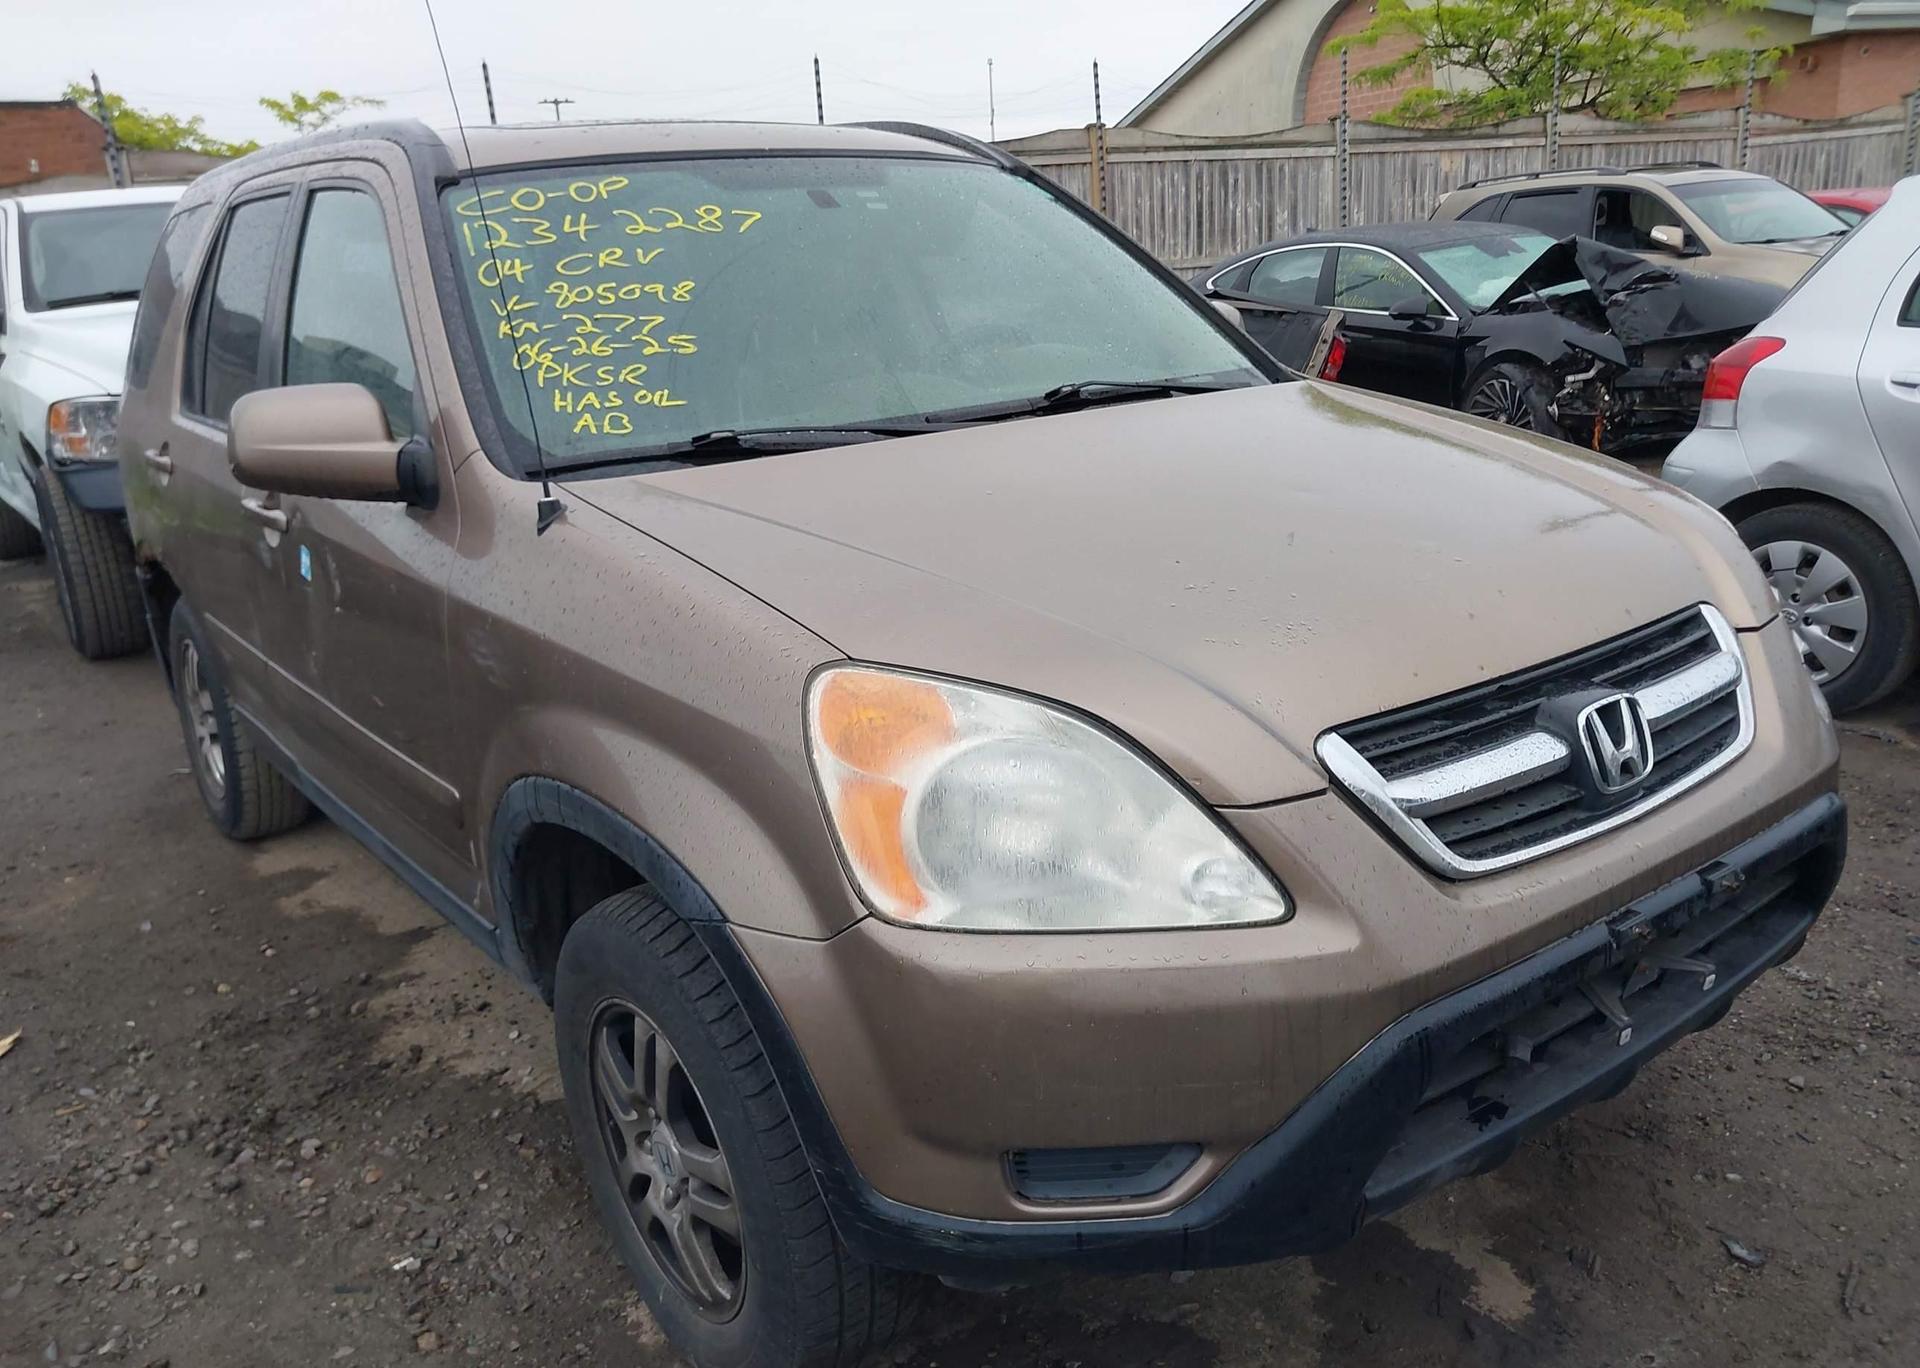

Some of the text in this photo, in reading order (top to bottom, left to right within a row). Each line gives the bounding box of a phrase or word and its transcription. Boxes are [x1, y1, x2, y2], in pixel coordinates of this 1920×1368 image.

[456, 176, 629, 216] CO-OP
[477, 247, 664, 287] 04 CRV
[545, 280, 695, 309] 805098
[513, 333, 698, 370] 06-26-25
[554, 389, 623, 413] HAS
[573, 412, 633, 434] AB
